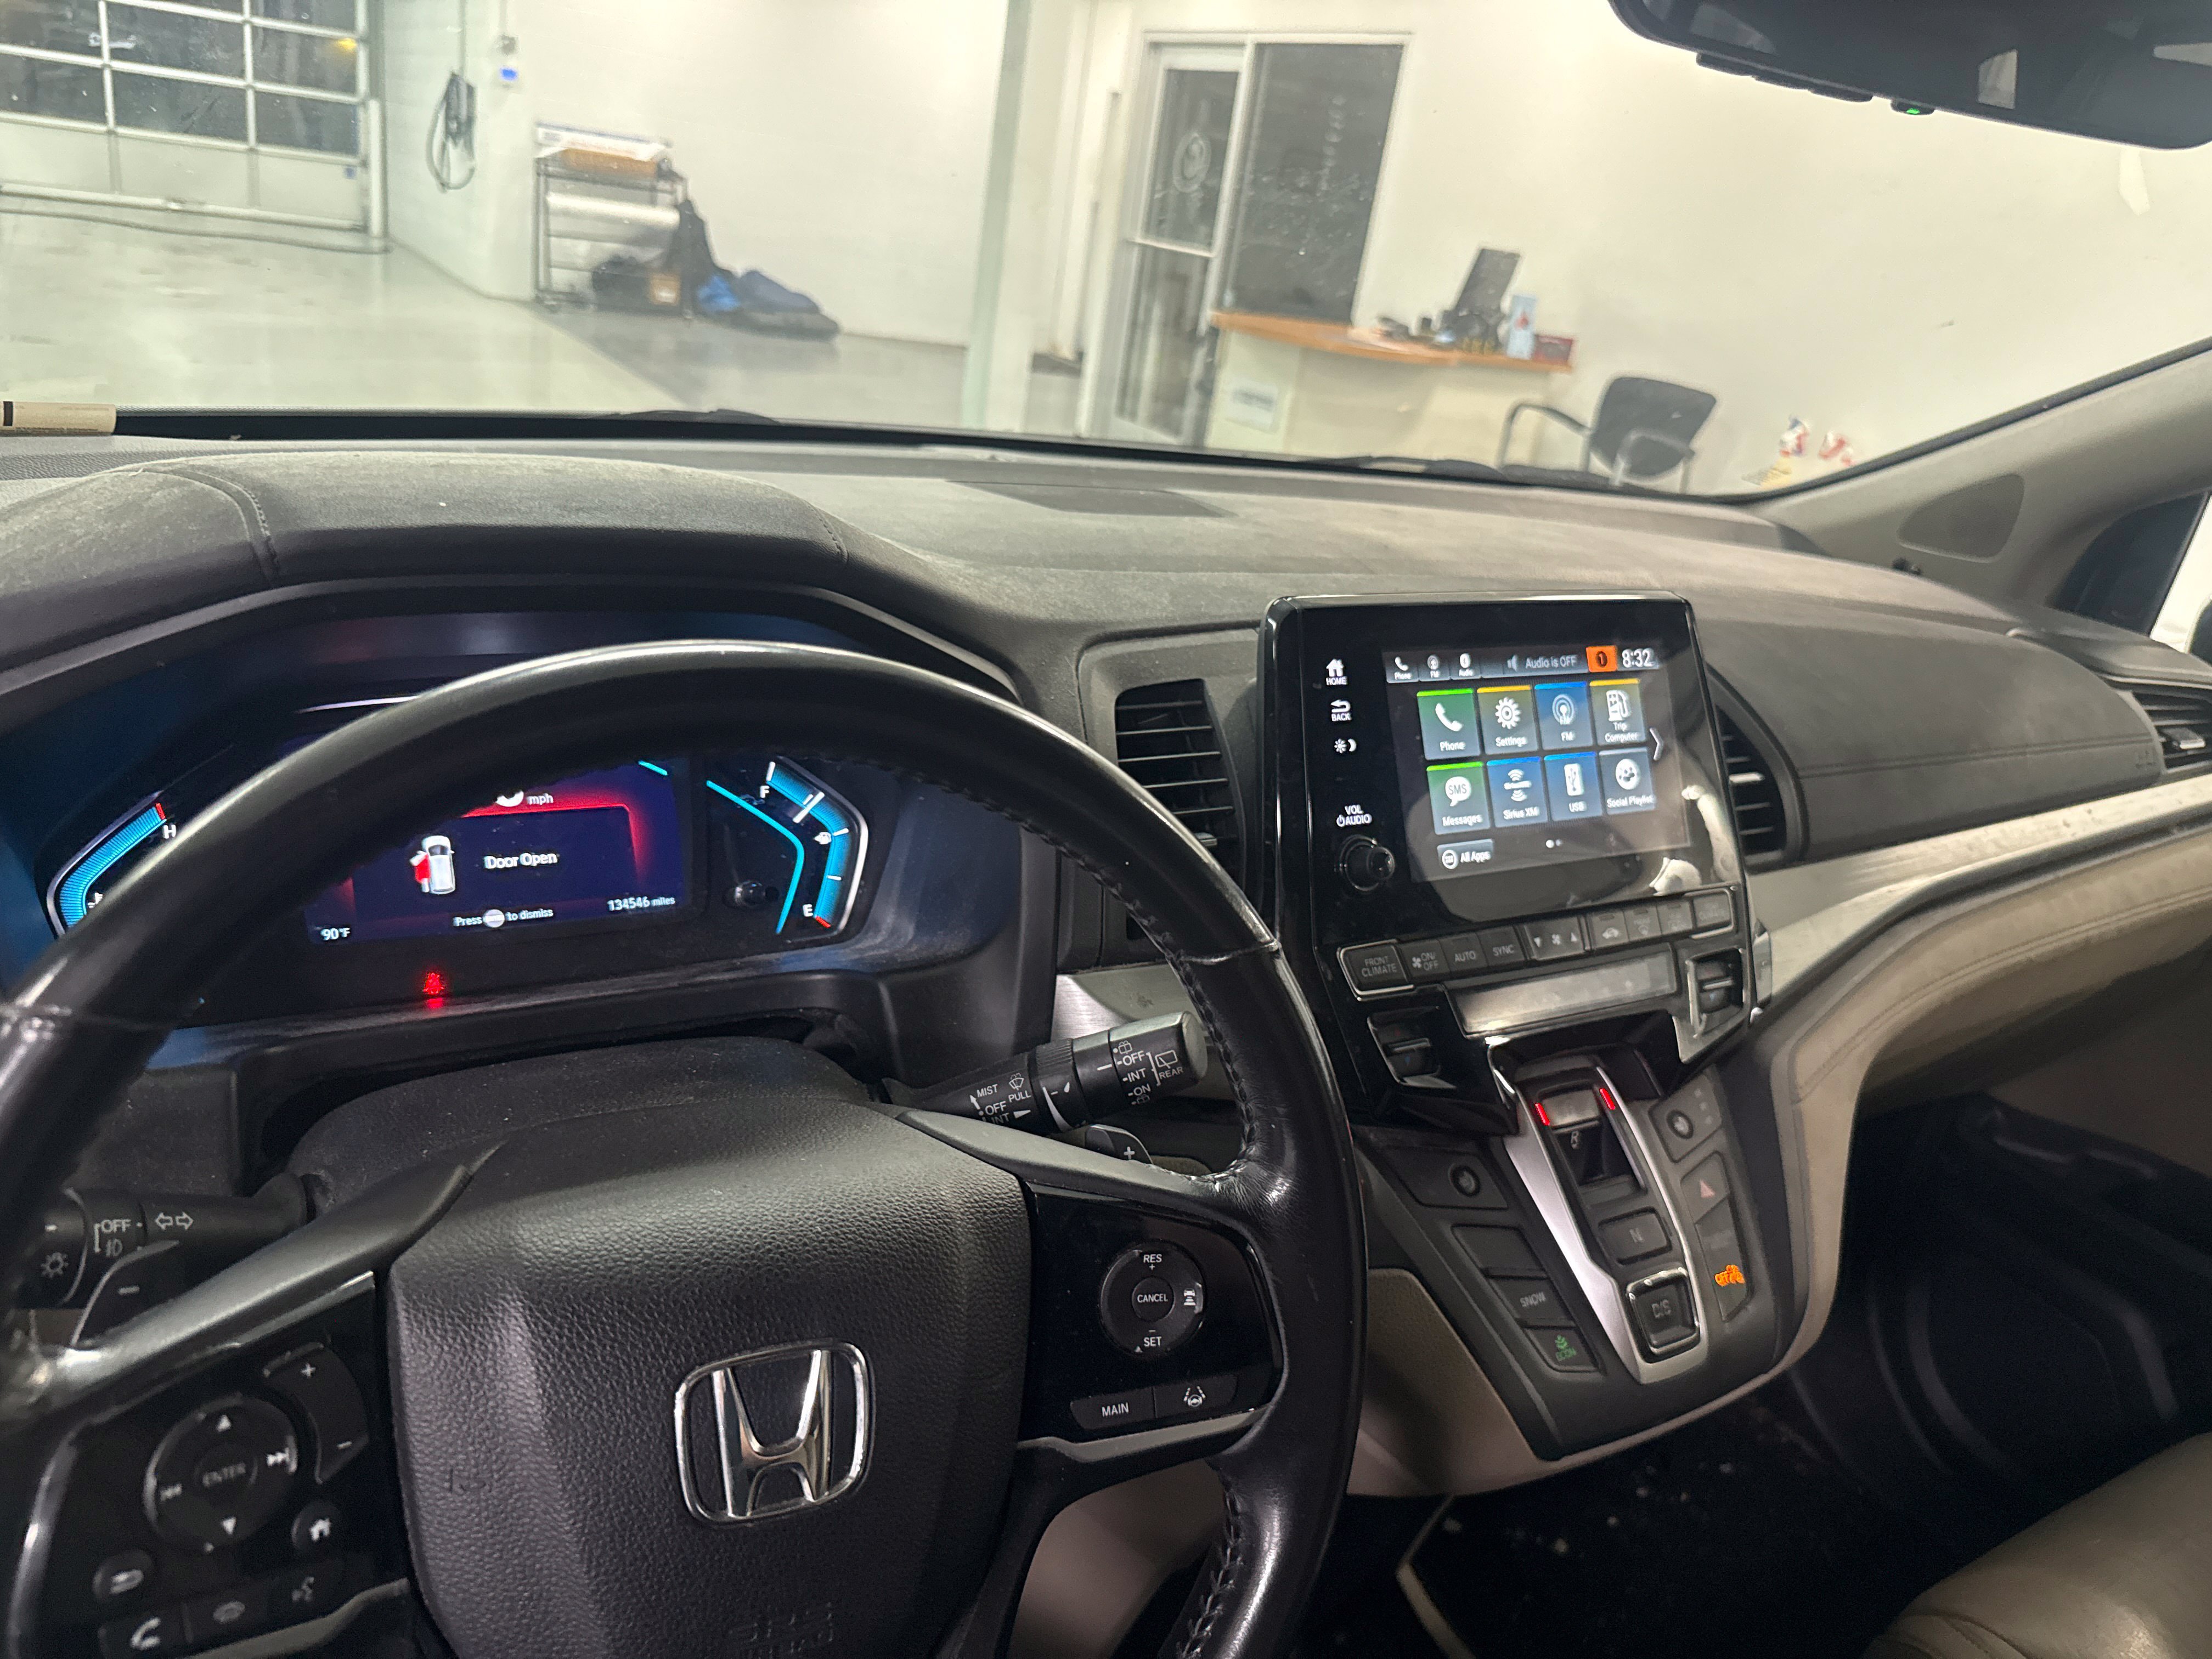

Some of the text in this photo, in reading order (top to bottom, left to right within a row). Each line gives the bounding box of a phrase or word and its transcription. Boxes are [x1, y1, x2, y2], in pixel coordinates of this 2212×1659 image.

[1526, 654, 1577, 669] Audio is OFF
[1622, 648, 1655, 668] 8:32
[1326, 676, 1348, 685] HOME
[1331, 713, 1352, 721] BACK
[1612, 722, 1627, 732] Trip
[1496, 736, 1527, 747] Settings
[1561, 732, 1575, 741] FM
[1605, 732, 1639, 743] Computer
[1440, 741, 1466, 751] Phone
[760, 786, 769, 798] F
[1448, 783, 1468, 795] SMS
[526, 793, 554, 805] mph
[1607, 794, 1656, 808] Social Playlist
[1344, 804, 1364, 815] VOL
[1503, 806, 1540, 820] Sirius XM
[1568, 801, 1587, 812] USB
[1345, 814, 1372, 825] AUDIO
[1442, 815, 1483, 827] Messages
[163, 824, 176, 839] H
[483, 851, 558, 870] Door Open
[1460, 851, 1491, 863] All Apps
[607, 896, 675, 911] 134546 miles
[803, 904, 813, 917] E
[453, 908, 554, 927] Press to dismiss
[321, 927, 351, 941] 90°F
[1454, 950, 1476, 963] AUTO
[1492, 944, 1515, 957] SYNC
[1364, 956, 1389, 967] FRONT
[1423, 961, 1440, 971] OFF
[1361, 963, 1398, 977] CLIMATE
[1122, 1050, 1145, 1065] OFF
[1127, 1068, 1146, 1082] INT
[1159, 1066, 1184, 1080] REAR
[977, 1084, 998, 1098] MIST
[1008, 1090, 1031, 1103] PULL
[1133, 1084, 1151, 1096] ON
[985, 1101, 1007, 1115] OFF
[101, 1220, 131, 1234] OFF
[1143, 1254, 1162, 1263] RES
[1137, 1293, 1169, 1304] CANCEL
[1520, 1291, 1546, 1307] SNOW
[1144, 1336, 1162, 1347] SET
[1102, 1402, 1130, 1418] MAIN
